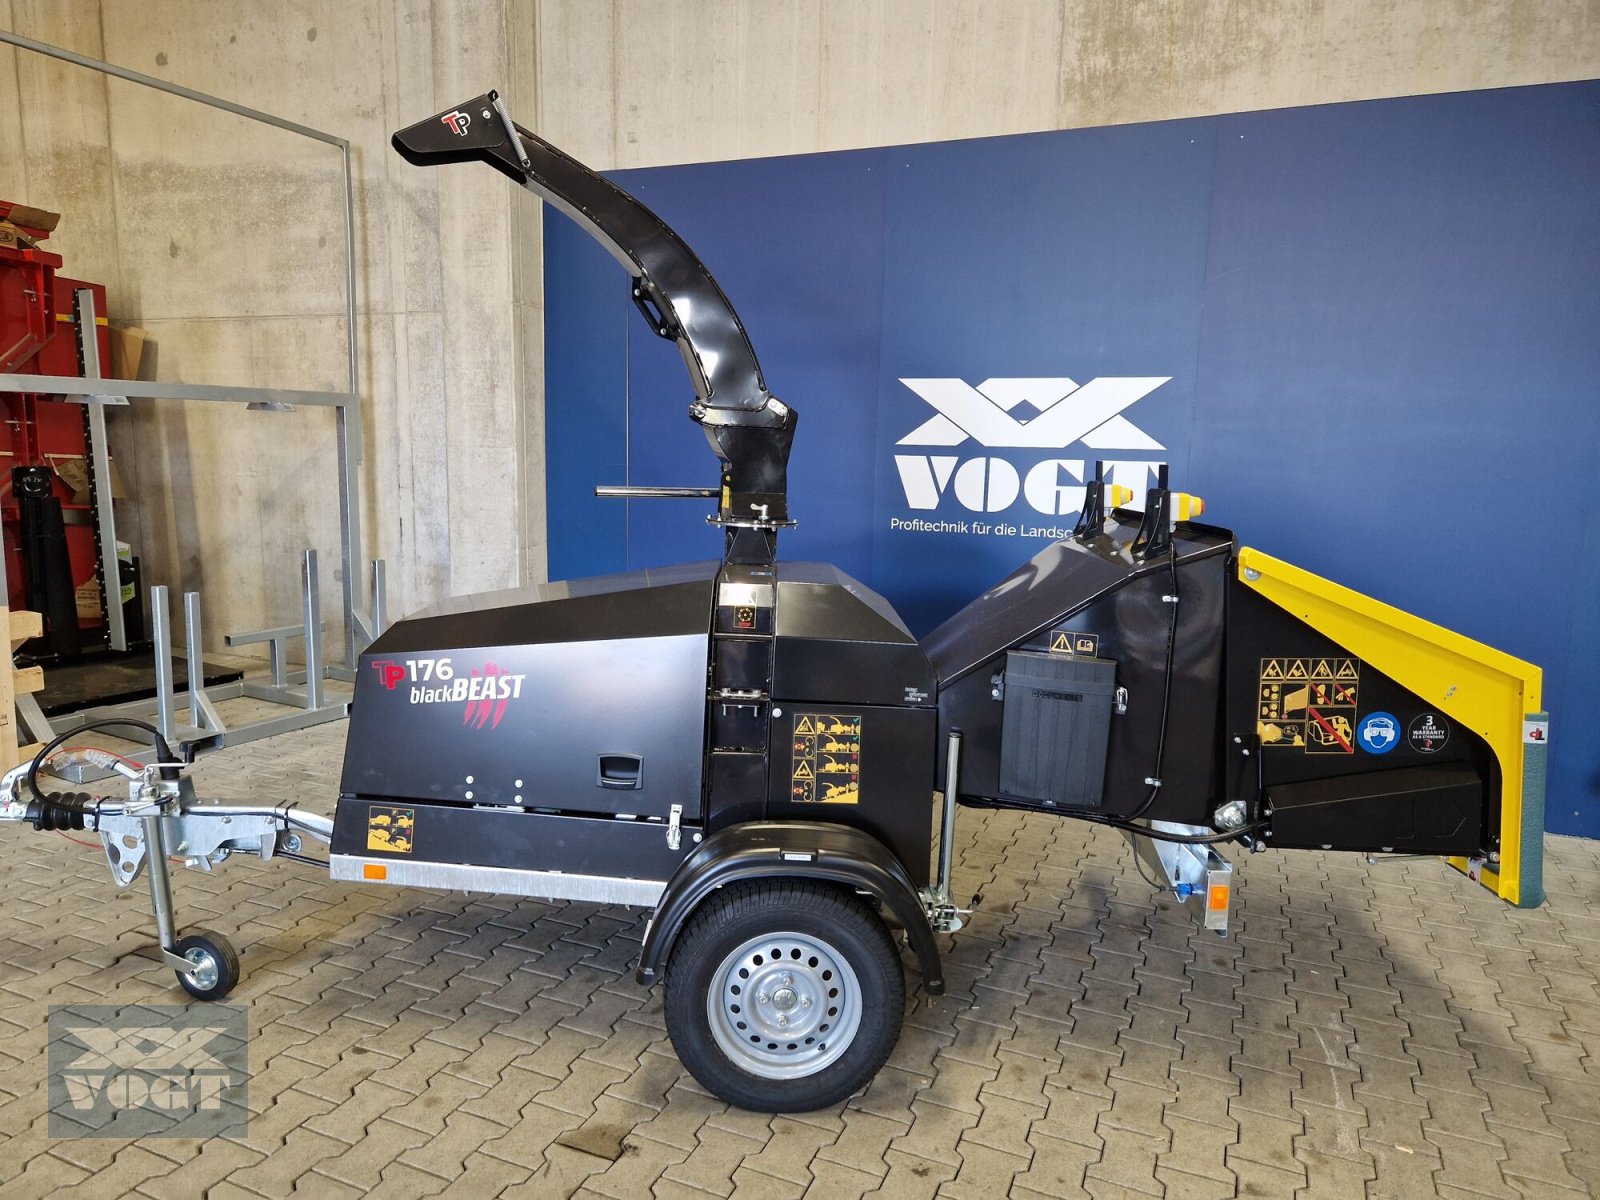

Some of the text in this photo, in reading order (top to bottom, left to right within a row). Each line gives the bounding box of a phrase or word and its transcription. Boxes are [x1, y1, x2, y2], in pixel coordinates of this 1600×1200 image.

[441, 111, 470, 136] TP
[895, 455, 1167, 516] VOGT
[890, 518, 1074, 538] Profitechnik für die Landsc
[372, 658, 454, 690] TP 176
[410, 674, 526, 704] blackBEAST
[1426, 715, 1434, 726] 3
